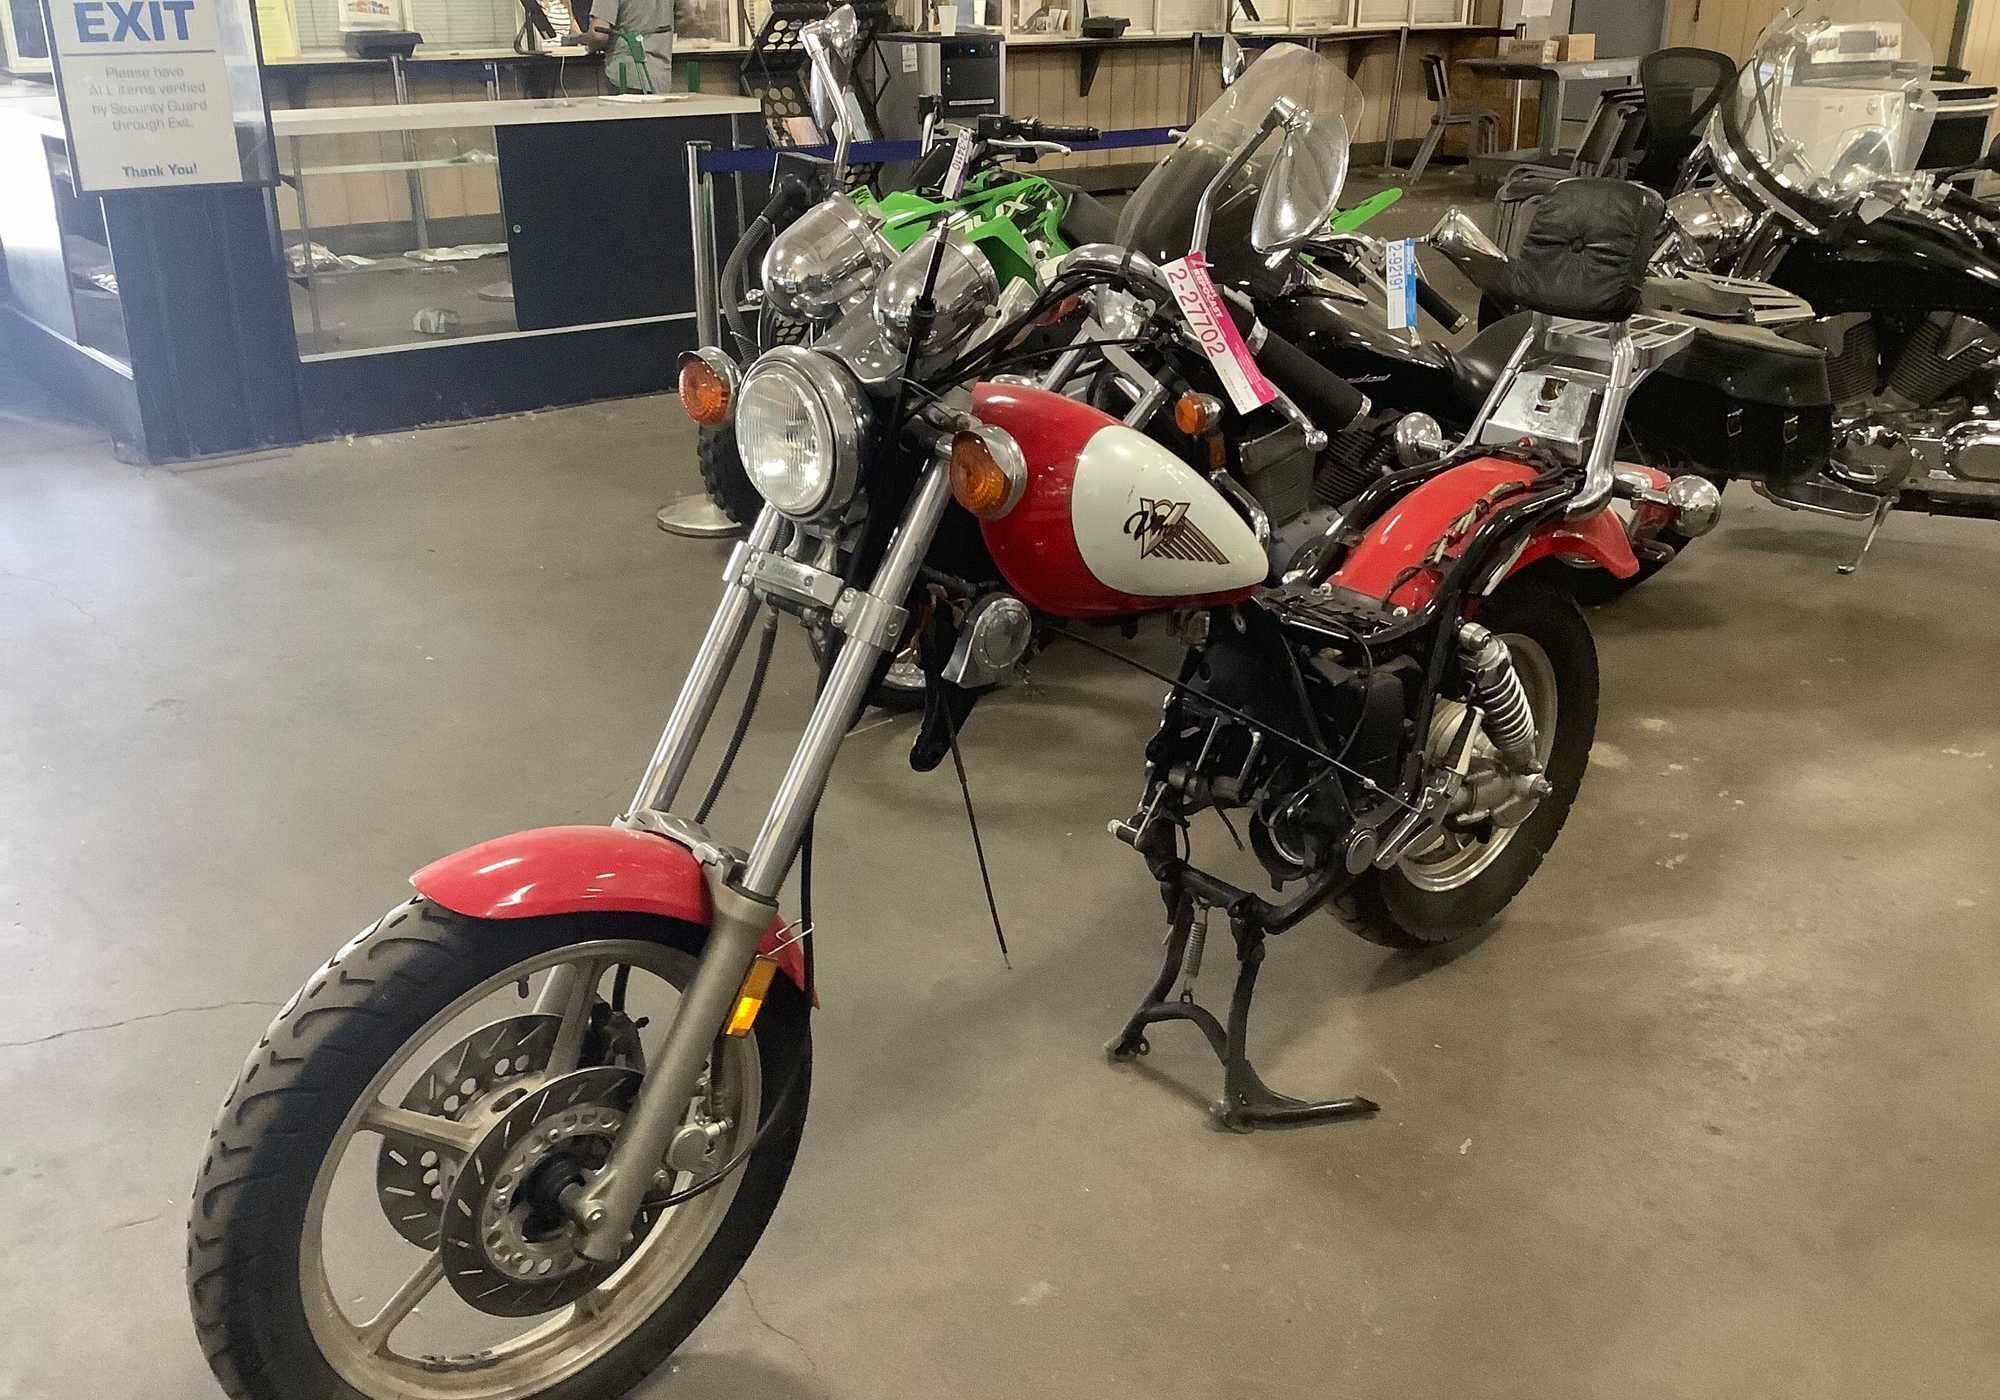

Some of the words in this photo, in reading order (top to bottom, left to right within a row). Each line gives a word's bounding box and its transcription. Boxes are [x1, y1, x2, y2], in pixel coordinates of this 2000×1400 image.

[74, 0, 195, 43] EXIT
[104, 66, 150, 80] Please
[153, 66, 185, 78] have
[118, 84, 157, 96] items
[158, 82, 206, 95] verified
[110, 101, 165, 115] Security
[167, 99, 207, 112] Guard
[112, 118, 165, 132] through
[121, 164, 164, 178] Thank
[168, 163, 198, 177] You!
[1388, 244, 1403, 293] 2-92191
[1168, 268, 1226, 358] 2-27702
